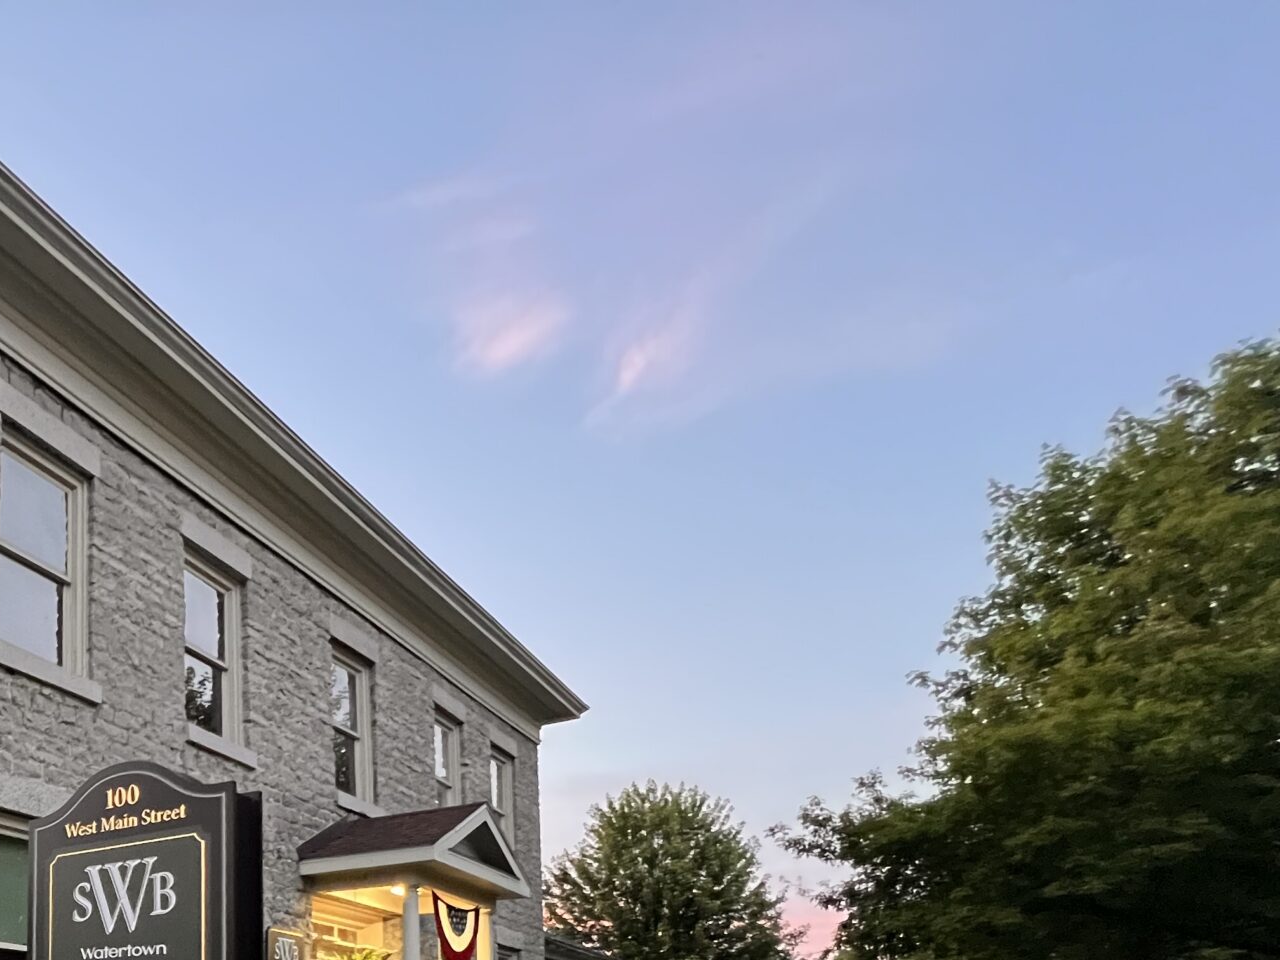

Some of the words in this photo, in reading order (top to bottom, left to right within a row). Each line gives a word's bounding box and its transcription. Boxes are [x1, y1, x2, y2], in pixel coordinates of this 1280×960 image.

[105, 784, 140, 809] 100
[64, 820, 97, 838] West
[100, 815, 138, 832] Main
[141, 803, 187, 825] Street
[80, 943, 167, 960] Watertown
